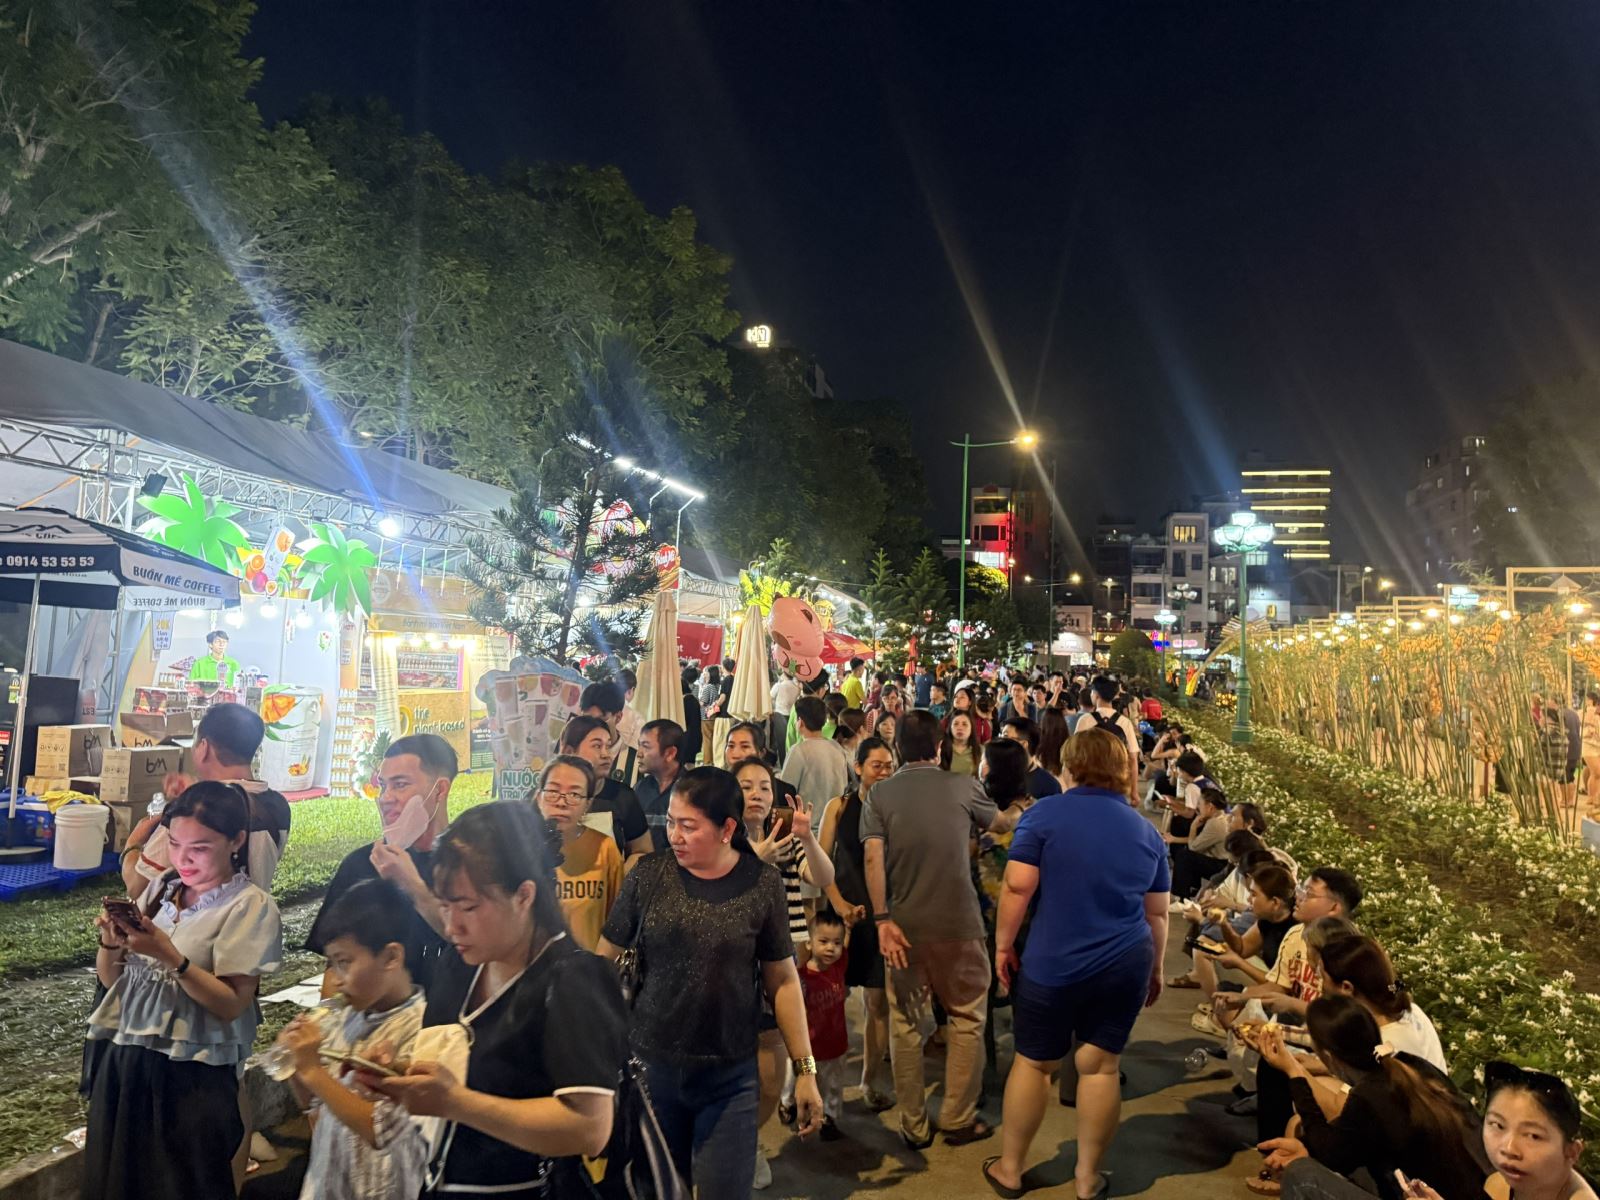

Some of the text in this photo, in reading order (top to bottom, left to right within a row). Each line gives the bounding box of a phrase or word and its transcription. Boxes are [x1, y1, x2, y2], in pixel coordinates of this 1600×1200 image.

[6, 556, 38, 567] 0914
[41, 557, 57, 567] 53
[60, 557, 76, 567] 53
[79, 557, 95, 567] 53
[183, 579, 222, 594] COFFEE
[414, 705, 430, 720] the
